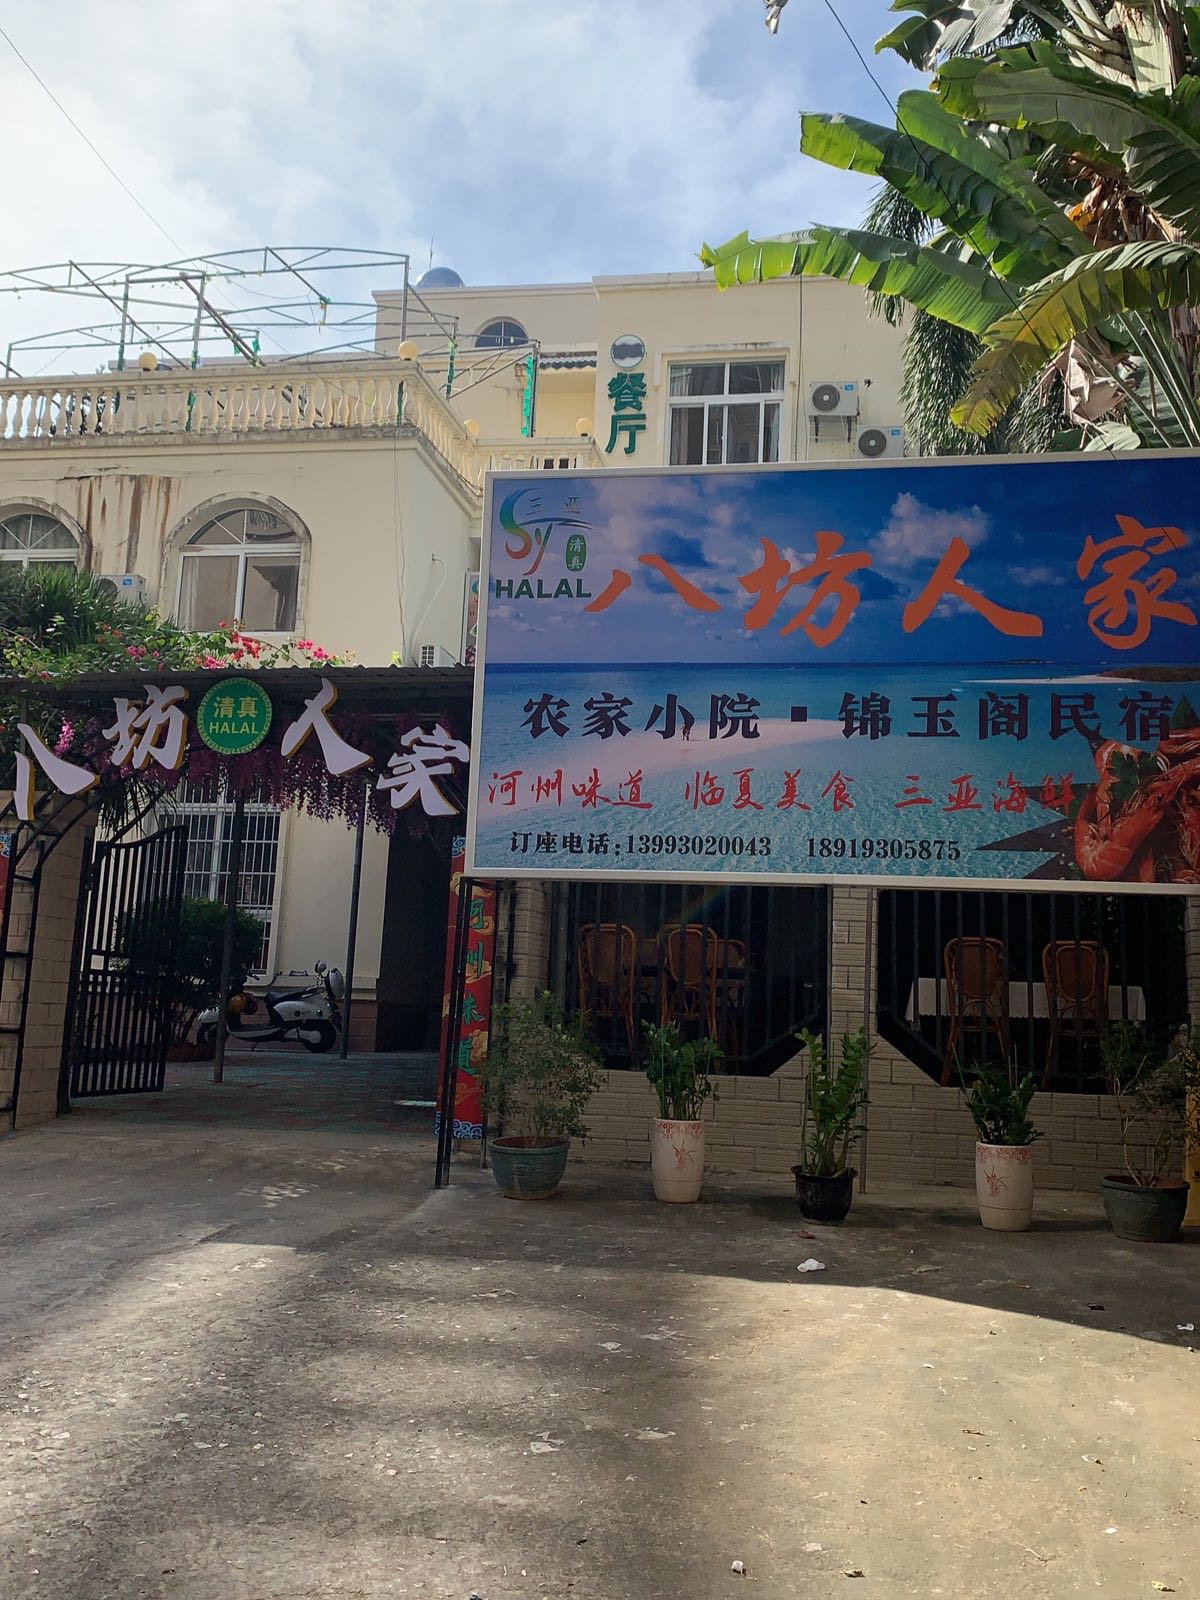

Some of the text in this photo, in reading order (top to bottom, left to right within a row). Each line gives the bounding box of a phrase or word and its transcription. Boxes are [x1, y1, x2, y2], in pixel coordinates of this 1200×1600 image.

[605, 372, 647, 455] 餐厅
[526, 497, 581, 516] 三亚
[568, 537, 585, 570] 清真
[496, 578, 592, 599] HALAL
[584, 514, 1198, 649] 八坊人家
[213, 696, 258, 718] 清真
[209, 721, 259, 735] HALAL
[489, 767, 1076, 815] 河州味道 临夏美食 三亚海鲜
[807, 837, 961, 861] 18919305875
